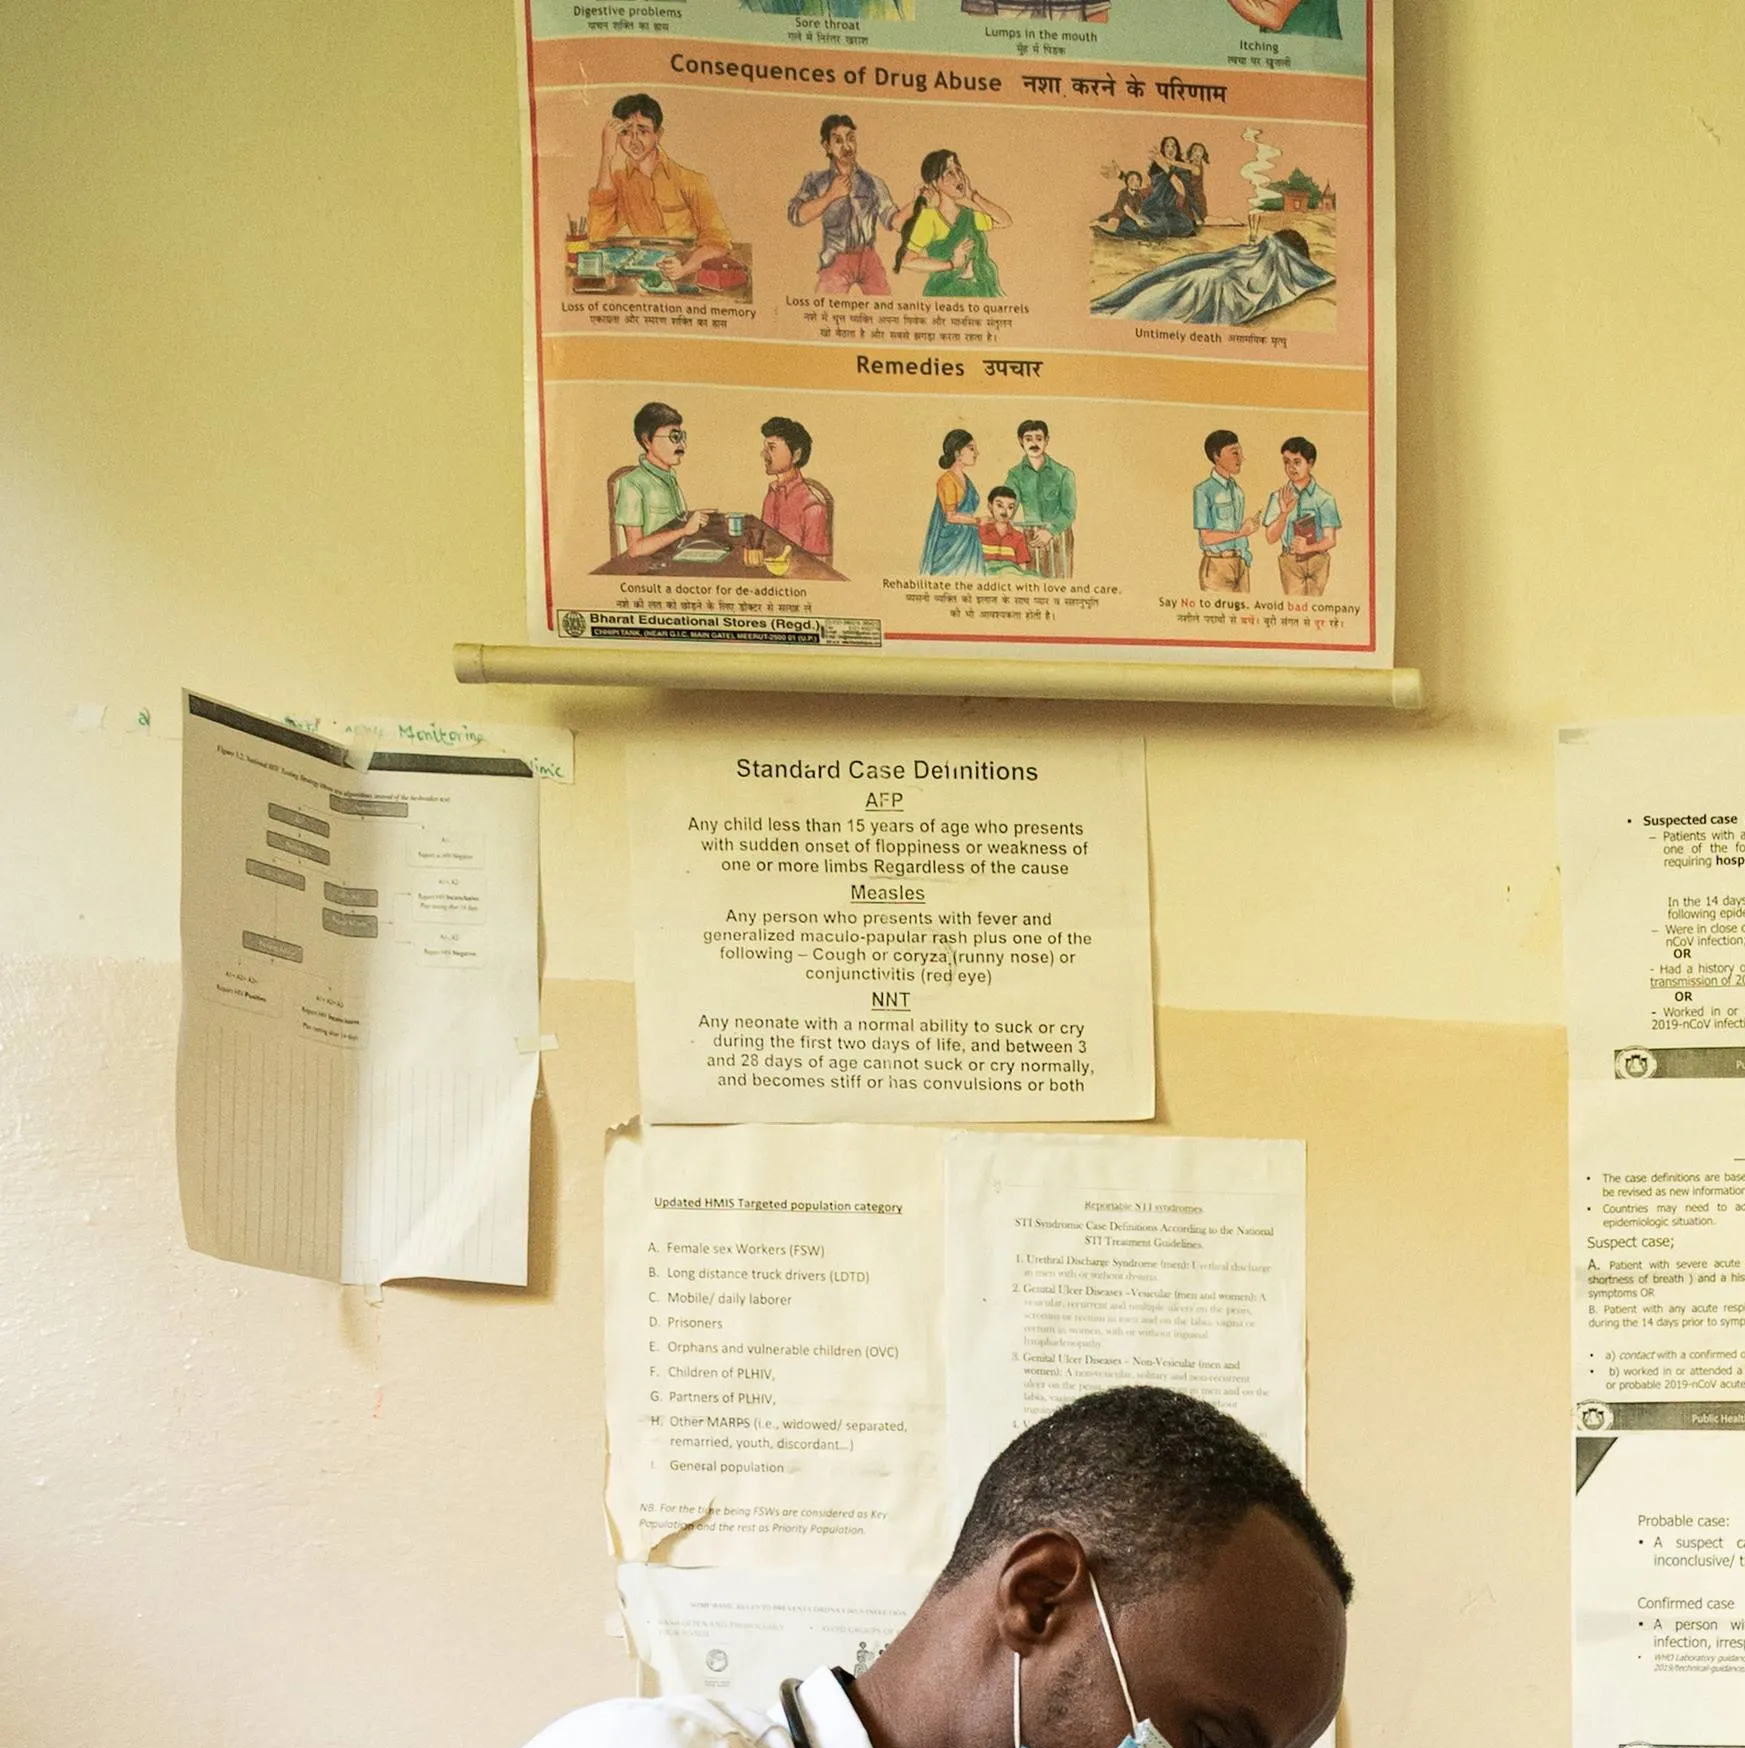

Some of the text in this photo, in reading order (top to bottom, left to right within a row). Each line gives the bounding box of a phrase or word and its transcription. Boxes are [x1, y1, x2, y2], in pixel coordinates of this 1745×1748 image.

[573, 6, 682, 19] Digestive problems
[795, 17, 861, 31] Sore throat
[984, 26, 1098, 42] Lumps in the mouth
[1239, 40, 1279, 54] Itching
[670, 54, 1002, 92] Consequences of Drug Abuse
[561, 301, 757, 319] Loss of concentration and memory
[785, 295, 1030, 314] Loss of temper and sanity leads to quarrels
[1135, 328, 1222, 343] Untimely death
[856, 355, 964, 376] Remedies
[619, 582, 662, 593] Consult
[664, 585, 672, 594] a
[674, 584, 712, 595] doctor
[715, 584, 732, 595] for
[882, 578, 951, 592] Rehabilitate
[954, 581, 973, 592] the
[976, 581, 1012, 593] addict
[1015, 582, 1040, 592] with
[1043, 582, 1067, 593] love
[1070, 584, 1090, 593] and
[1158, 596, 1178, 608] Say
[1180, 598, 1196, 609] No
[1199, 599, 1211, 608] to
[1254, 600, 1285, 612] Avoid
[1287, 602, 1309, 612] bad
[1311, 604, 1360, 618] company
[590, 613, 635, 625] Bharat
[638, 614, 719, 627] Educational
[723, 617, 767, 629] Stores
[736, 758, 840, 779] Standard
[848, 760, 905, 779] Case
[688, 816, 1084, 837] Any child less than 15 years of age who presents
[1643, 814, 1707, 827] Suspected
[1710, 815, 1738, 824] case
[851, 884, 925, 901] Measles
[1673, 948, 1691, 959] OR
[872, 991, 910, 1007] NNT
[1674, 991, 1693, 1002] OR
[654, 1197, 903, 1215] Updated HMIS Targeted population category
[666, 1242, 710, 1254] Female
[712, 1245, 732, 1254] sex
[735, 1243, 786, 1255] Workers
[1586, 1236, 1638, 1250] Suspect
[667, 1316, 723, 1329] Prisoners
[1638, 1514, 1694, 1527] Probable
[1653, 1536, 1663, 1548] A
[1675, 1537, 1724, 1551] suspect
[1637, 1596, 1735, 1610] Confirmed case
